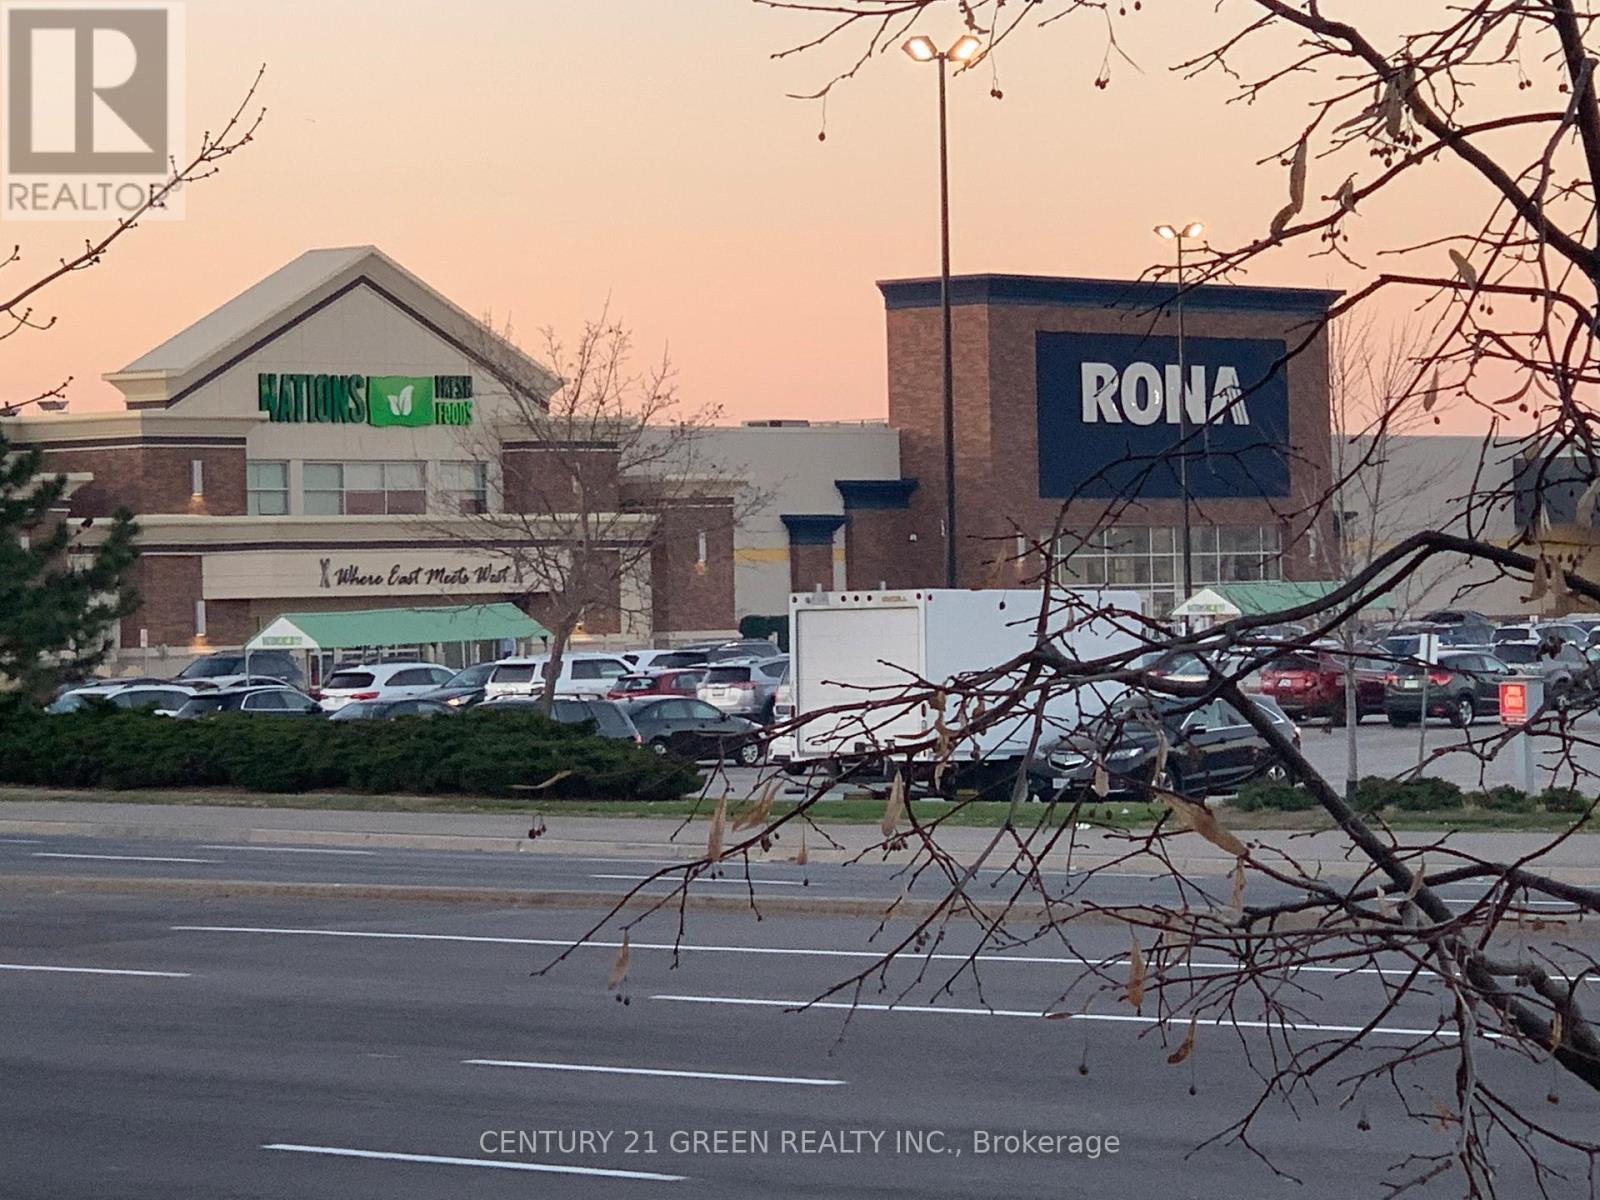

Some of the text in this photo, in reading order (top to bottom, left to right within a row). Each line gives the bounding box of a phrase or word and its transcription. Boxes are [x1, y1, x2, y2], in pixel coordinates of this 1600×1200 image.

[258, 373, 367, 424] NATIONS
[1080, 362, 1250, 426] RONA
[434, 401, 473, 426] FOODS
[335, 563, 511, 585] Where East Meets West
